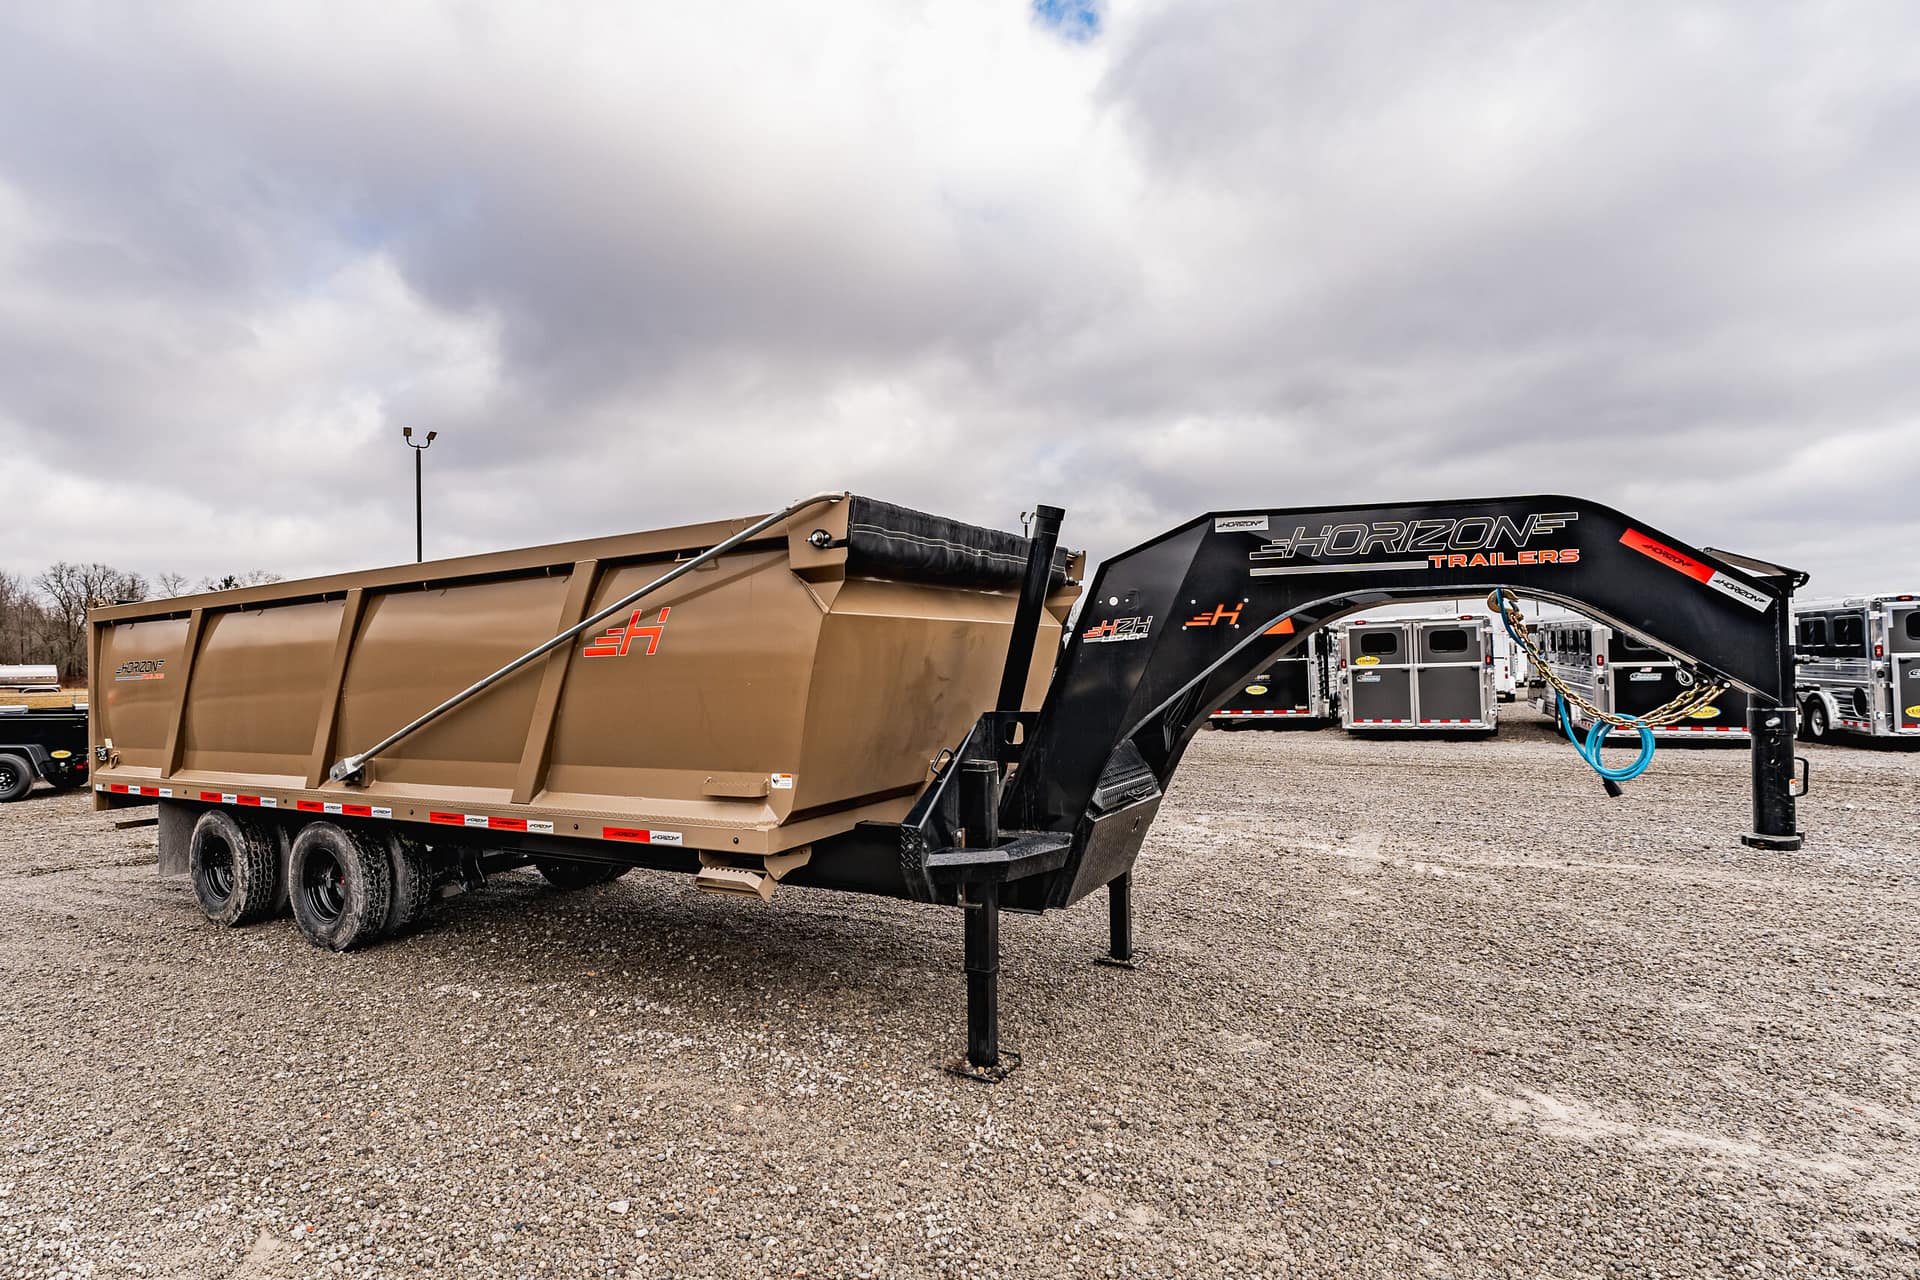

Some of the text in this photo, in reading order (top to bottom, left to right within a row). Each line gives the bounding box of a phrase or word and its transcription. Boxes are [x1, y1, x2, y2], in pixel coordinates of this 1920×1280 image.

[1221, 520, 1259, 528] HORIZON
[1285, 514, 1538, 558] HORIZON
[1428, 549, 1579, 568] TRAILERS
[1648, 545, 1688, 567] HORIZON
[1719, 580, 1760, 602] HORIZON
[121, 660, 158, 674] HORIZON
